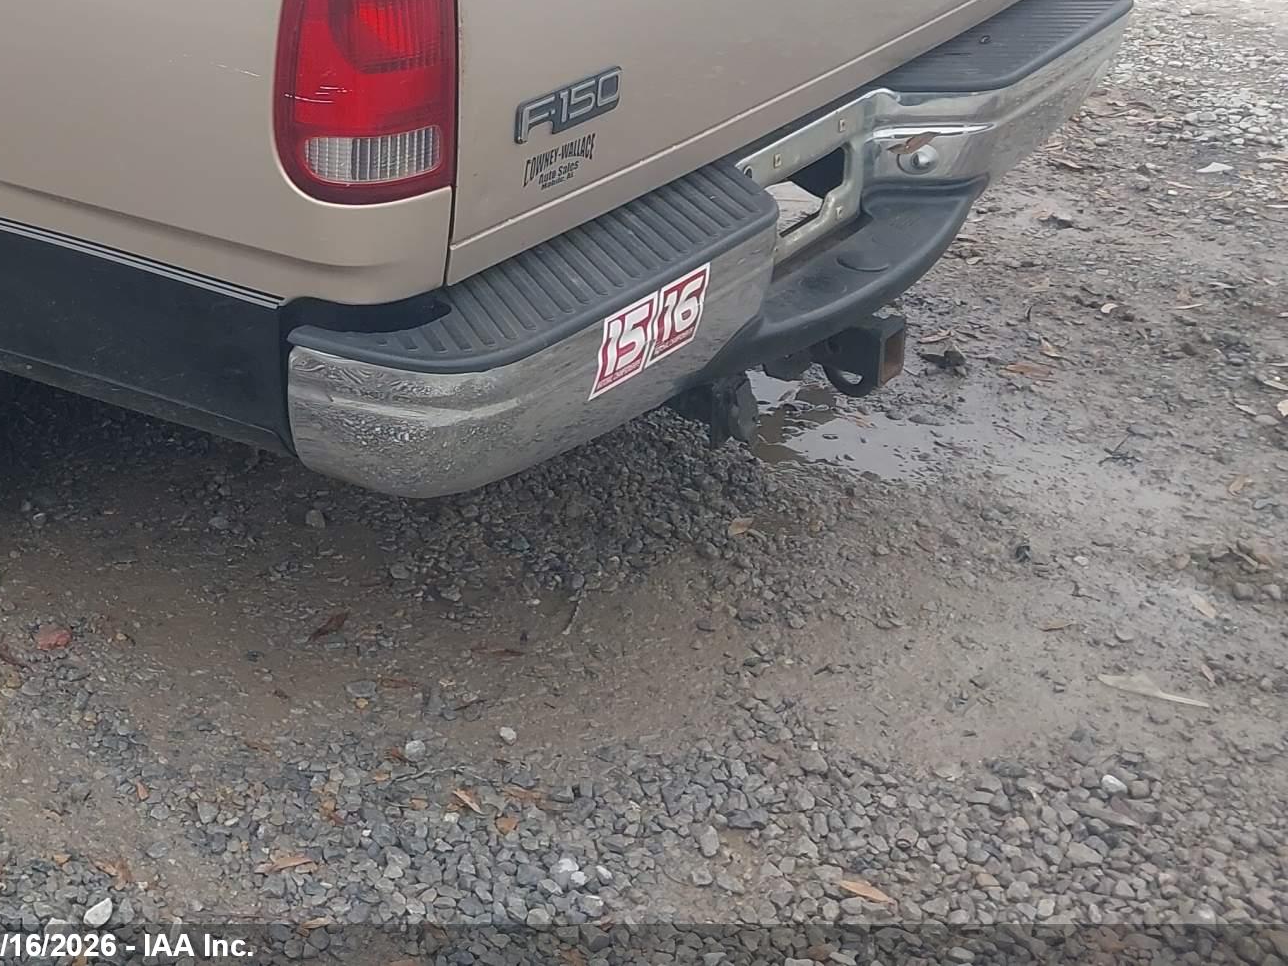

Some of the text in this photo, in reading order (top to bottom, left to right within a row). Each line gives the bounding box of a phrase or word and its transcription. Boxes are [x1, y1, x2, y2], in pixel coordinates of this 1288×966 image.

[538, 160, 580, 185] Auto Sales
[603, 302, 651, 378] 15
[662, 274, 705, 342] 16
